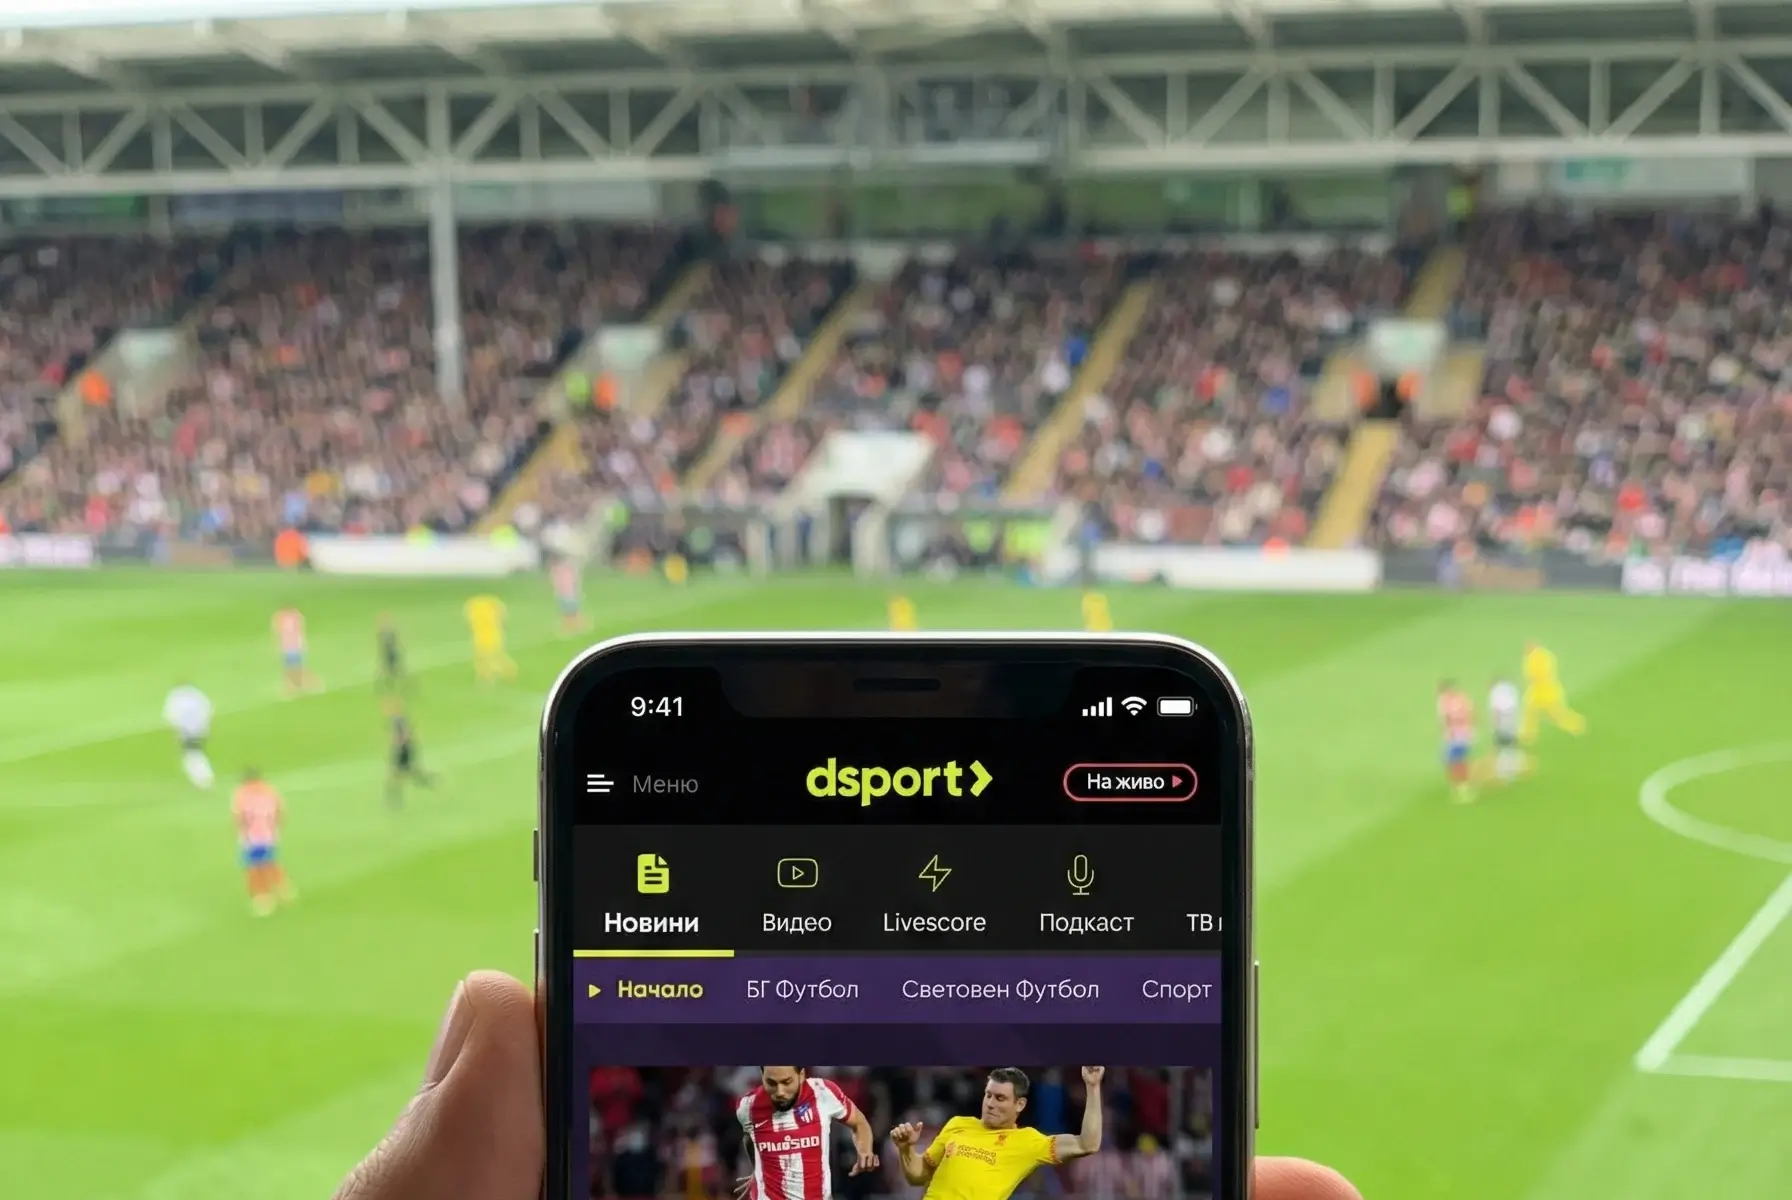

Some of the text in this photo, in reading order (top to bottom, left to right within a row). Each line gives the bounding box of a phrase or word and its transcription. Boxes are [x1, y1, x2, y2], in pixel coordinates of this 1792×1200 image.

[630, 696, 682, 717] 9:41
[633, 774, 699, 794] Меню
[806, 757, 963, 807] dsport
[1087, 772, 1165, 790] На живо
[604, 912, 699, 933] Новини
[763, 913, 832, 935] Видео
[884, 912, 987, 932] Livescore
[1040, 913, 1135, 935] Подкаст
[1186, 913, 1213, 932] ТВ
[618, 980, 704, 998] Начало
[747, 979, 859, 1003] БГ Футбол
[902, 978, 1099, 1004] Световен Футбол
[1142, 979, 1213, 1003] Спорт
